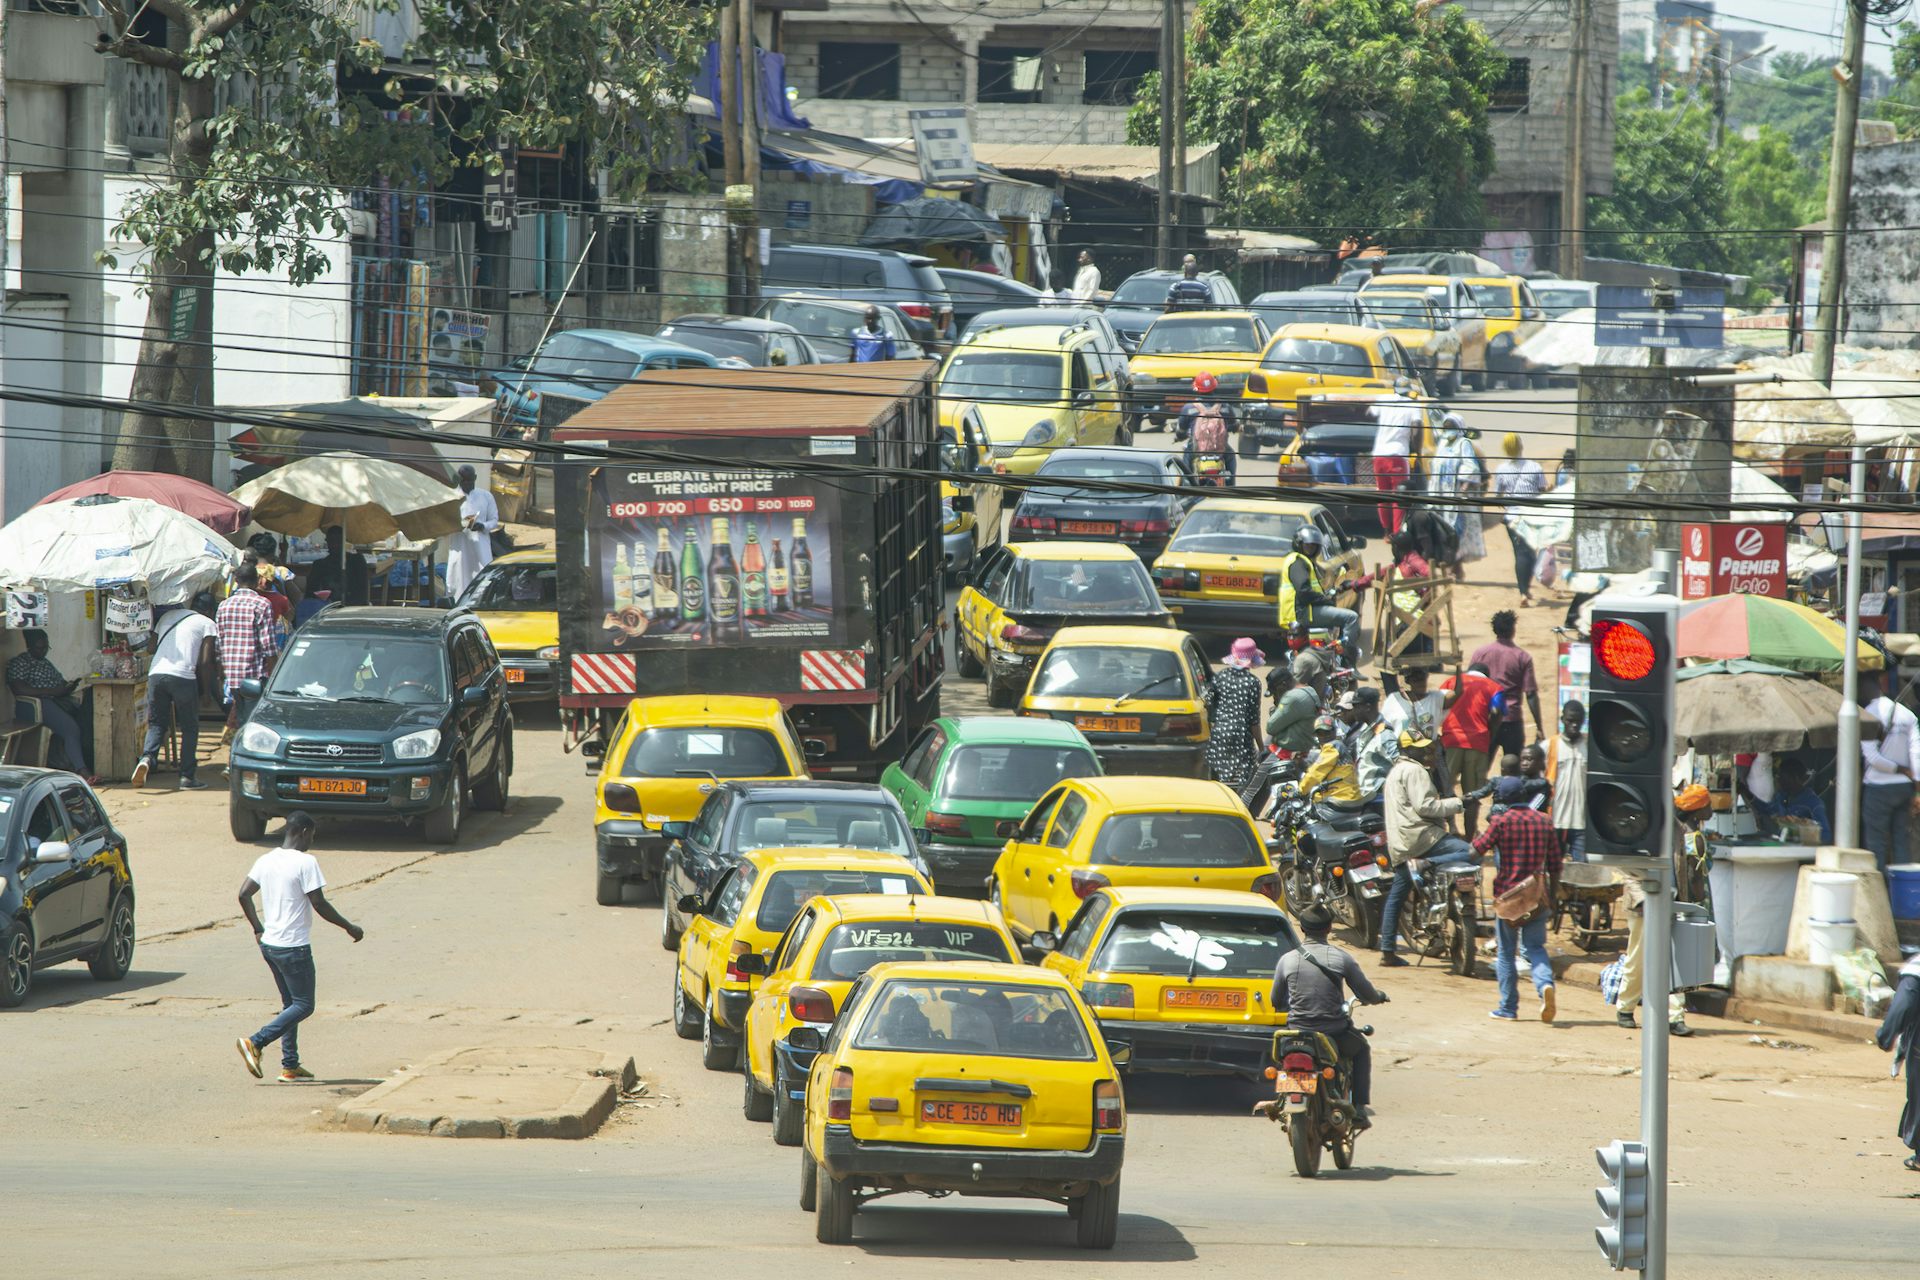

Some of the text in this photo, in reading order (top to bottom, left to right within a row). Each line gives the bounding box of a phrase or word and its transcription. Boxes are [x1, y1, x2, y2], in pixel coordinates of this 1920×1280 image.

[627, 471, 711, 485] CELEBRATE
[653, 480, 774, 495] THE RIGHT PRICE
[615, 504, 648, 516] 600
[658, 502, 687, 514] 700
[708, 498, 743, 512] 650
[757, 499, 783, 510] 500
[789, 499, 813, 508] 1050
[1719, 556, 1781, 576] PREMIER
[1730, 576, 1771, 595] Loto
[12, 593, 38, 628] 25
[108, 601, 130, 613] Transfert
[107, 617, 130, 629] Orange
[137, 619, 150, 627] MTN
[309, 780, 324, 792] LT
[325, 780, 345, 792] 871
[944, 930, 974, 946] VIP
[1178, 991, 1193, 1005] CE
[1200, 992, 1220, 1007] 692
[937, 1103, 955, 1119] CE
[963, 1105, 988, 1121] 156
